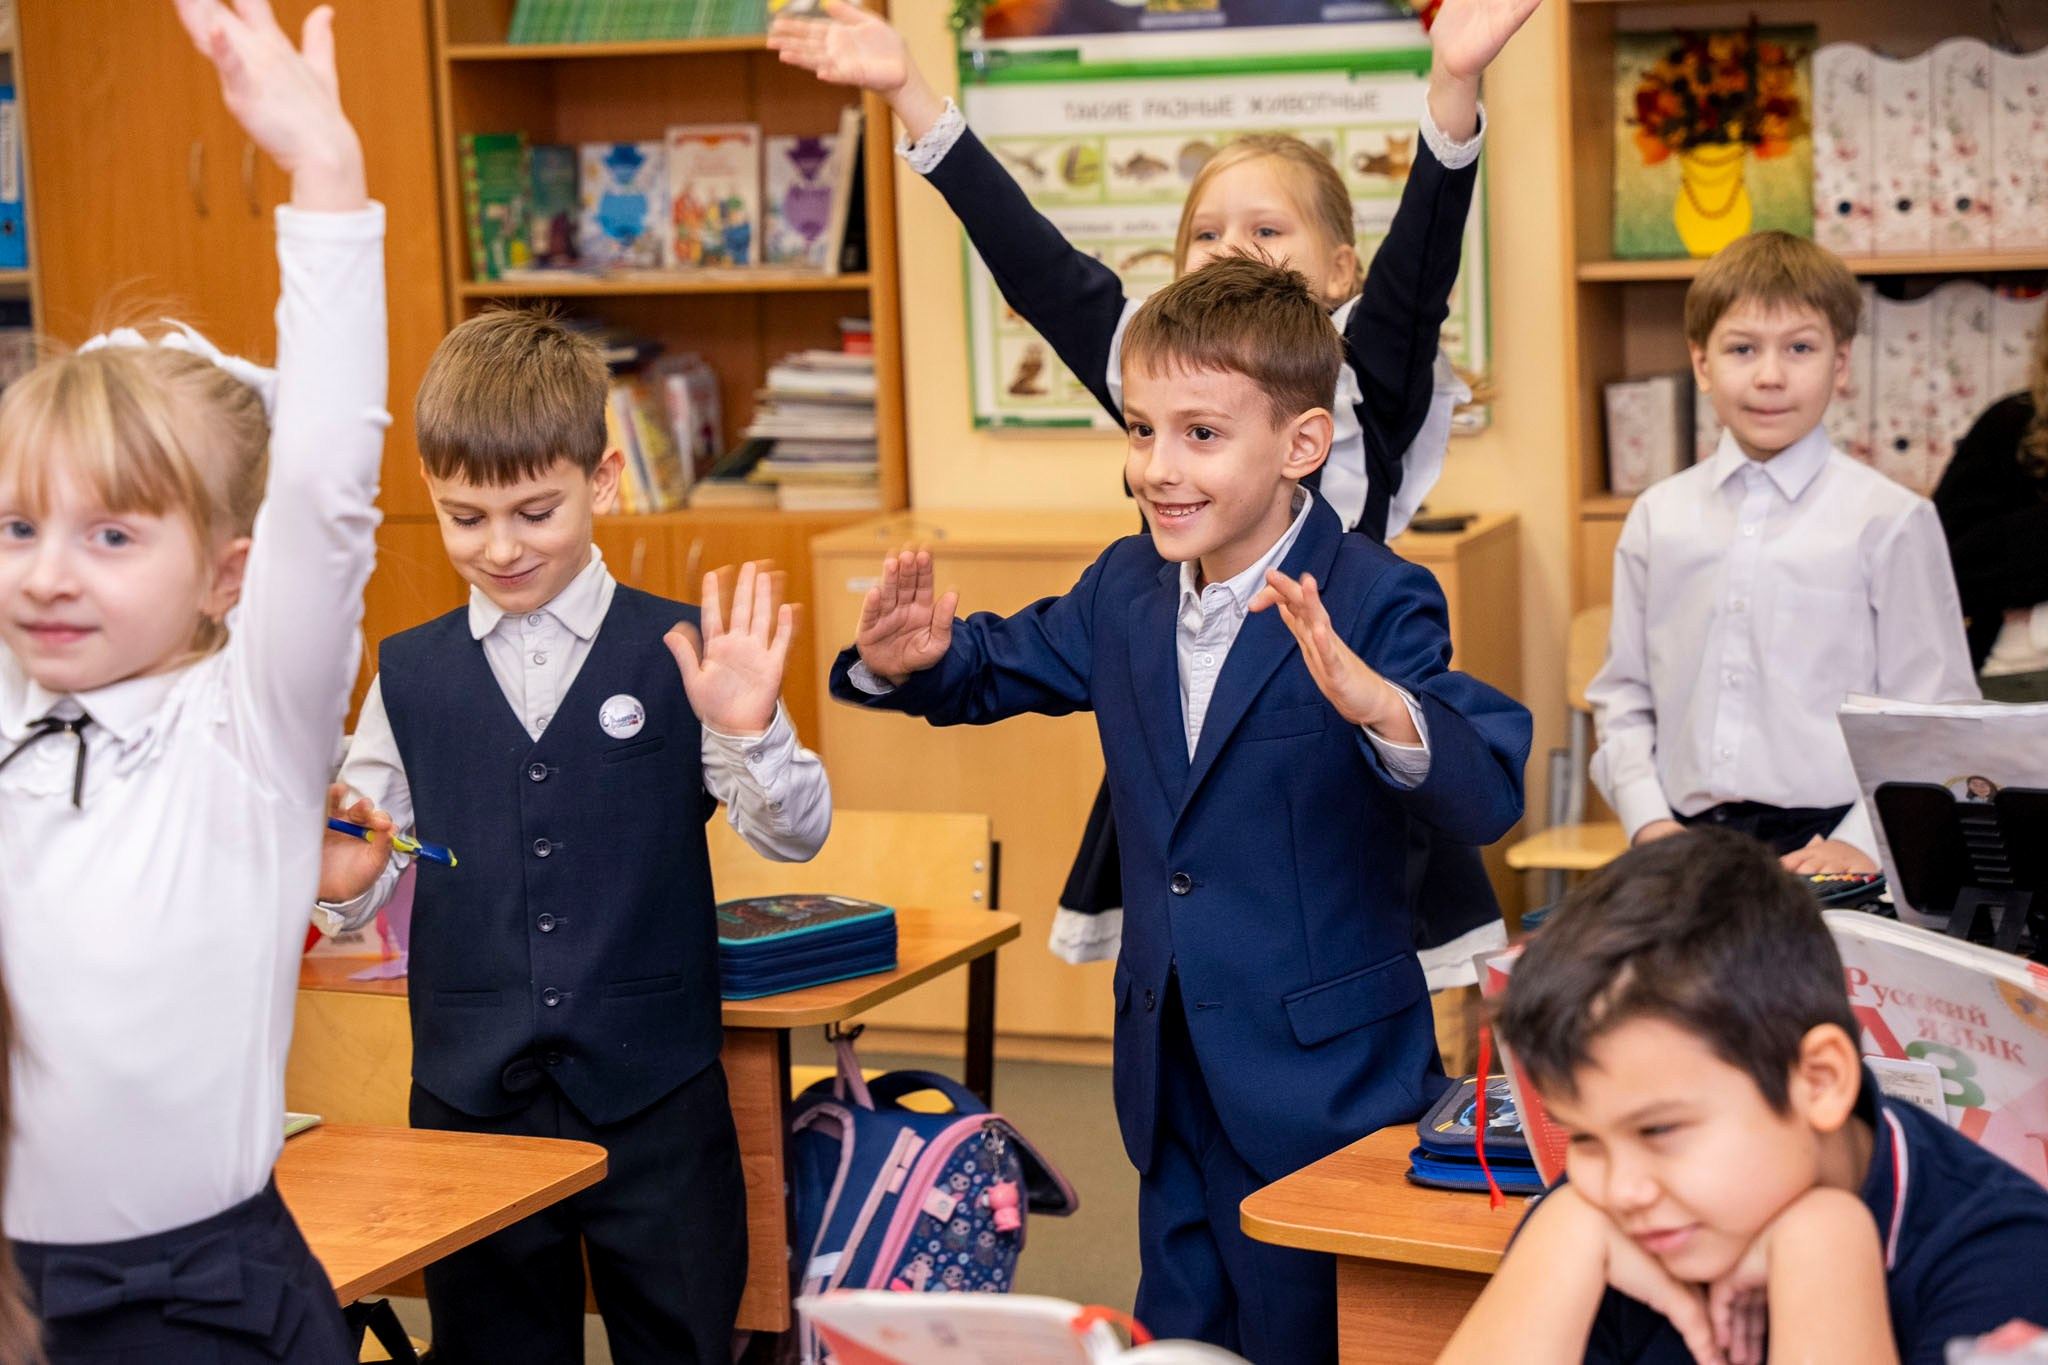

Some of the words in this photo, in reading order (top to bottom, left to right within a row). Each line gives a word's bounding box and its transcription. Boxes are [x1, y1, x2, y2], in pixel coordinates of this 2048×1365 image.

[1063, 100, 1133, 121] ТАКИЕ
[1142, 98, 1232, 118] РАЗНЫЕ
[1249, 92, 1379, 115] ЖИВОТНЫЕ
